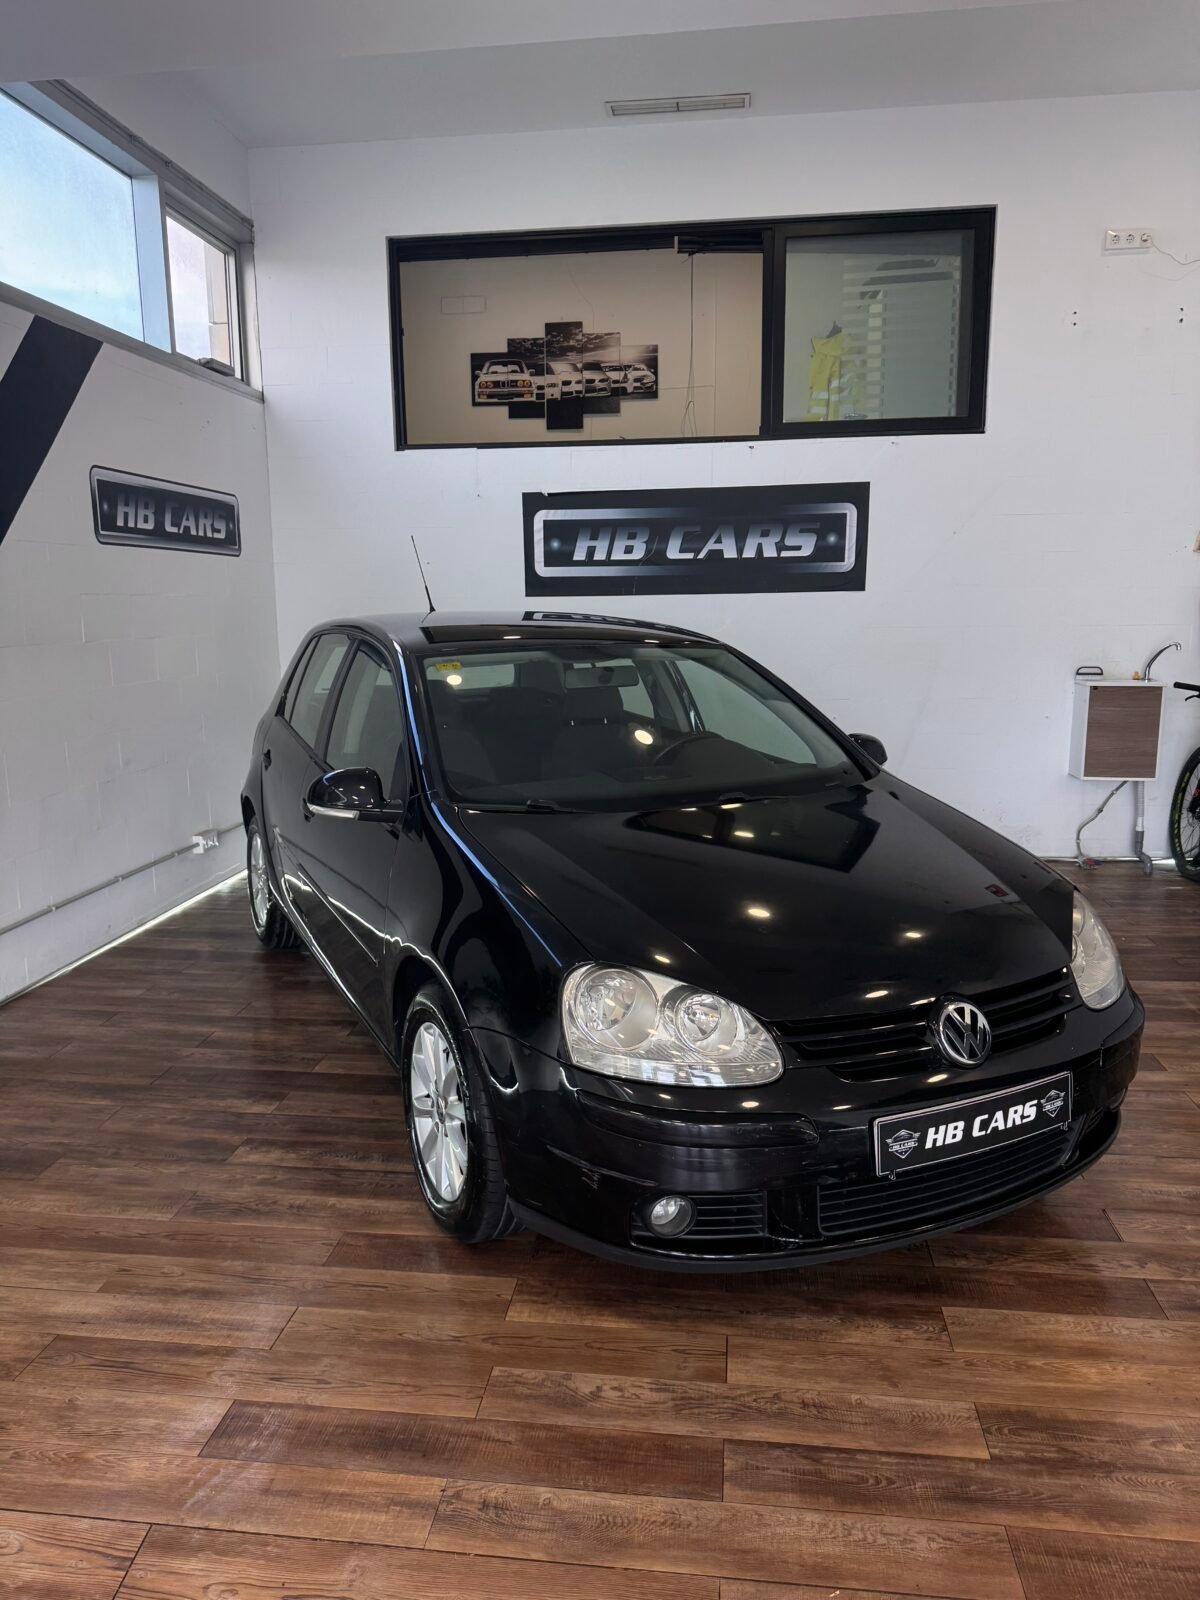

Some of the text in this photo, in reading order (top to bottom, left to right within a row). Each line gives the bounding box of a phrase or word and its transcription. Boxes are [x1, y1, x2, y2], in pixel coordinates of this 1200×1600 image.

[116, 494, 227, 539] HB CARS
[572, 522, 820, 561] HB CARS
[925, 1099, 1038, 1149] HB CARS
